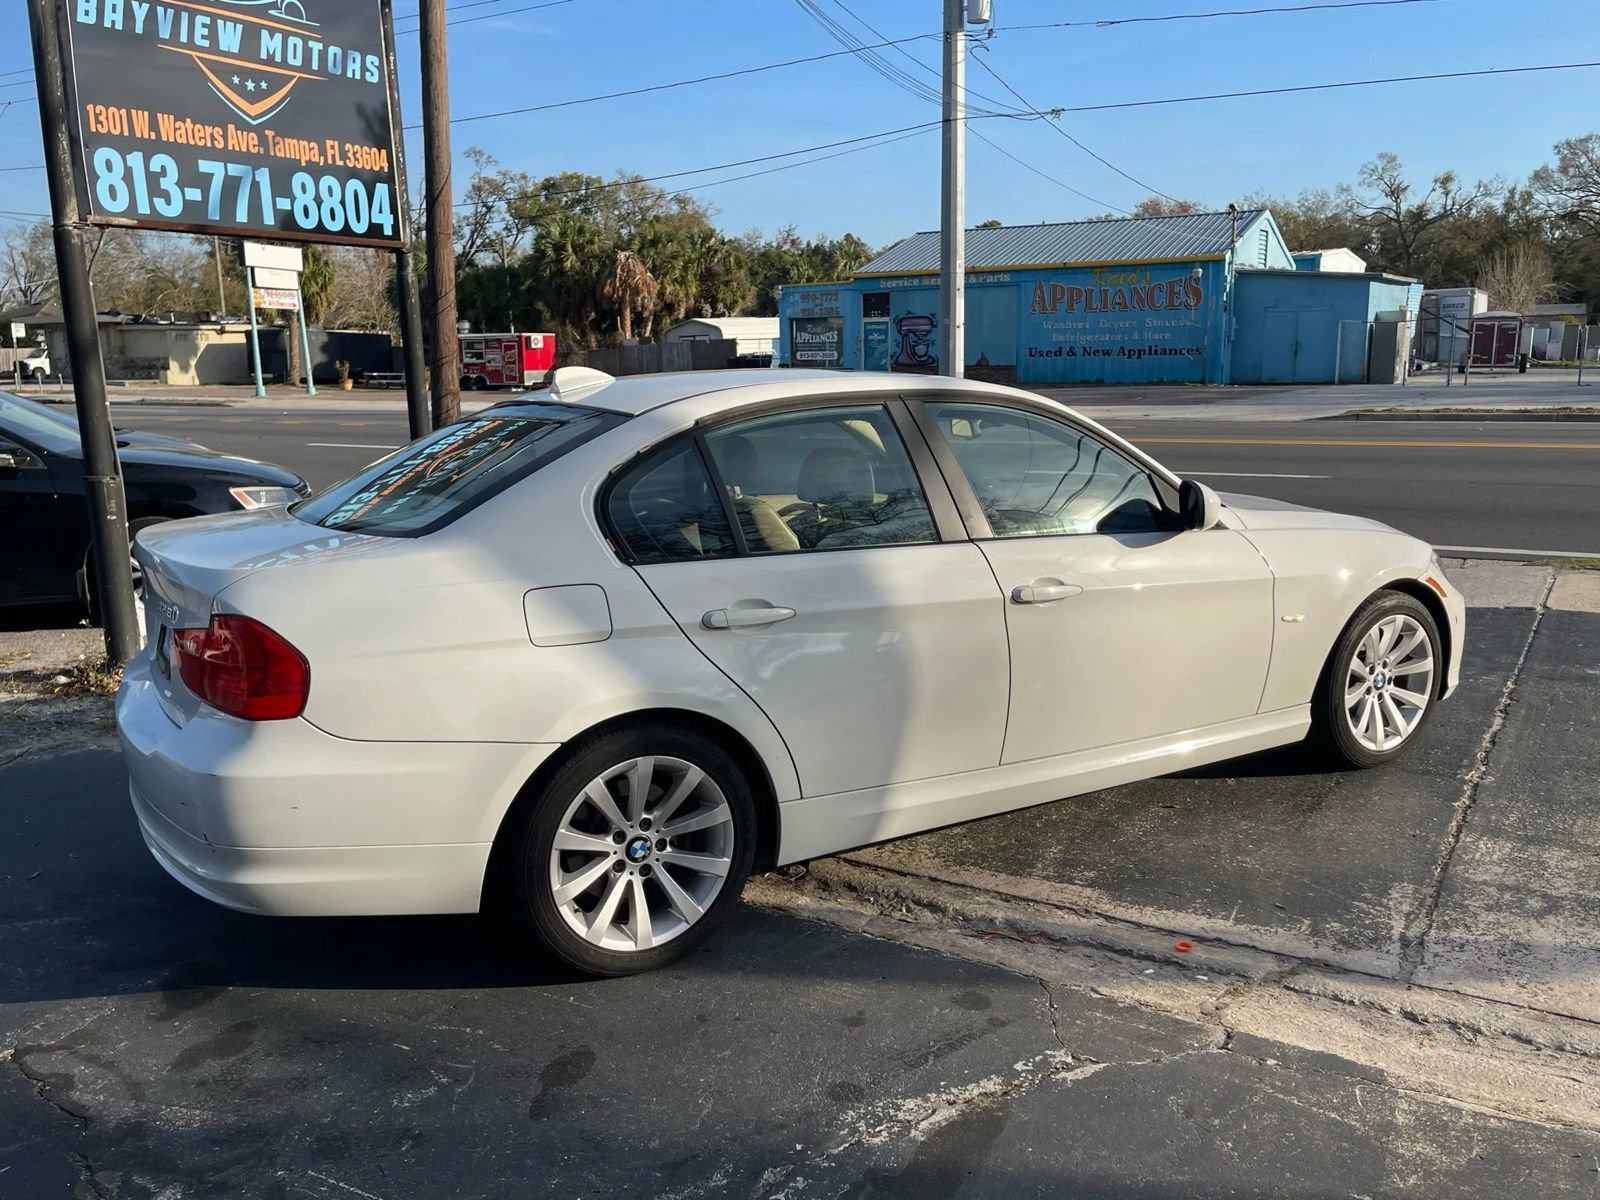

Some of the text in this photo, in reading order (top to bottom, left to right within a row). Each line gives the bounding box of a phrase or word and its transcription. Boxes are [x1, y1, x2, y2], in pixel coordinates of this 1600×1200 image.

[76, 0, 380, 84] BAYVIEW MOTORS
[86, 103, 389, 172] 1301 W. Waters Ave. Tampa, FL 33604
[93, 147, 394, 236] 813-771-8804
[880, 278, 919, 288] Service
[979, 272, 1011, 283] Parts
[1030, 275, 1203, 315] APPLIANCES
[1042, 320, 1090, 329] Washers
[1099, 319, 1137, 331] Dryers
[796, 330, 839, 344] APPLIANCES
[1052, 332, 1128, 344] Refrigerators
[1142, 329, 1171, 340] More
[1028, 344, 1203, 360] Used & New Appliances
